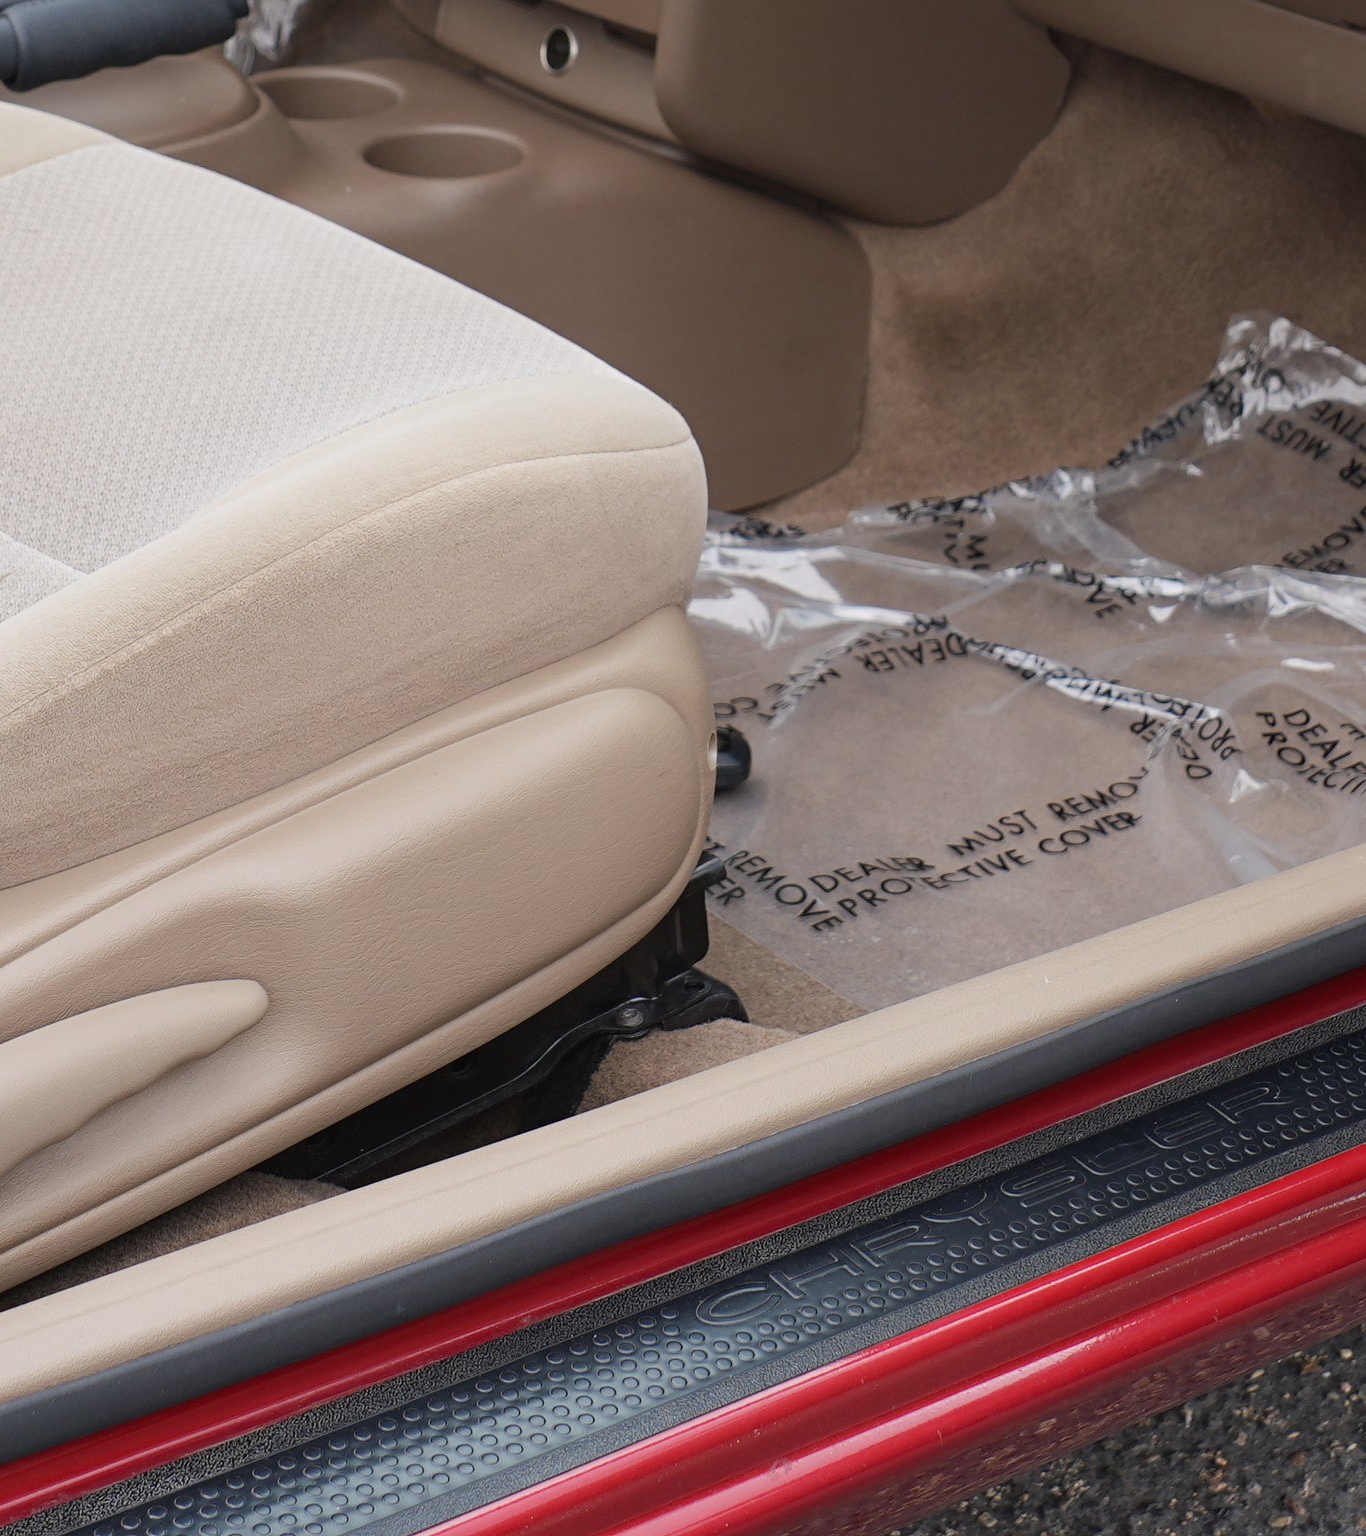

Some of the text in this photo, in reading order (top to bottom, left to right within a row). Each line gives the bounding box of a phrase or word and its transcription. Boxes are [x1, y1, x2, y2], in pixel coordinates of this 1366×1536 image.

[1257, 413, 1331, 461] MUST
[854, 630, 971, 674] DEALER
[808, 766, 1150, 894] DEALER MUST REMO
[837, 810, 1143, 918] PROTECTIVE COVER
[722, 849, 844, 932] REMOVE
[695, 1082, 1294, 1327] CHRYSLER
